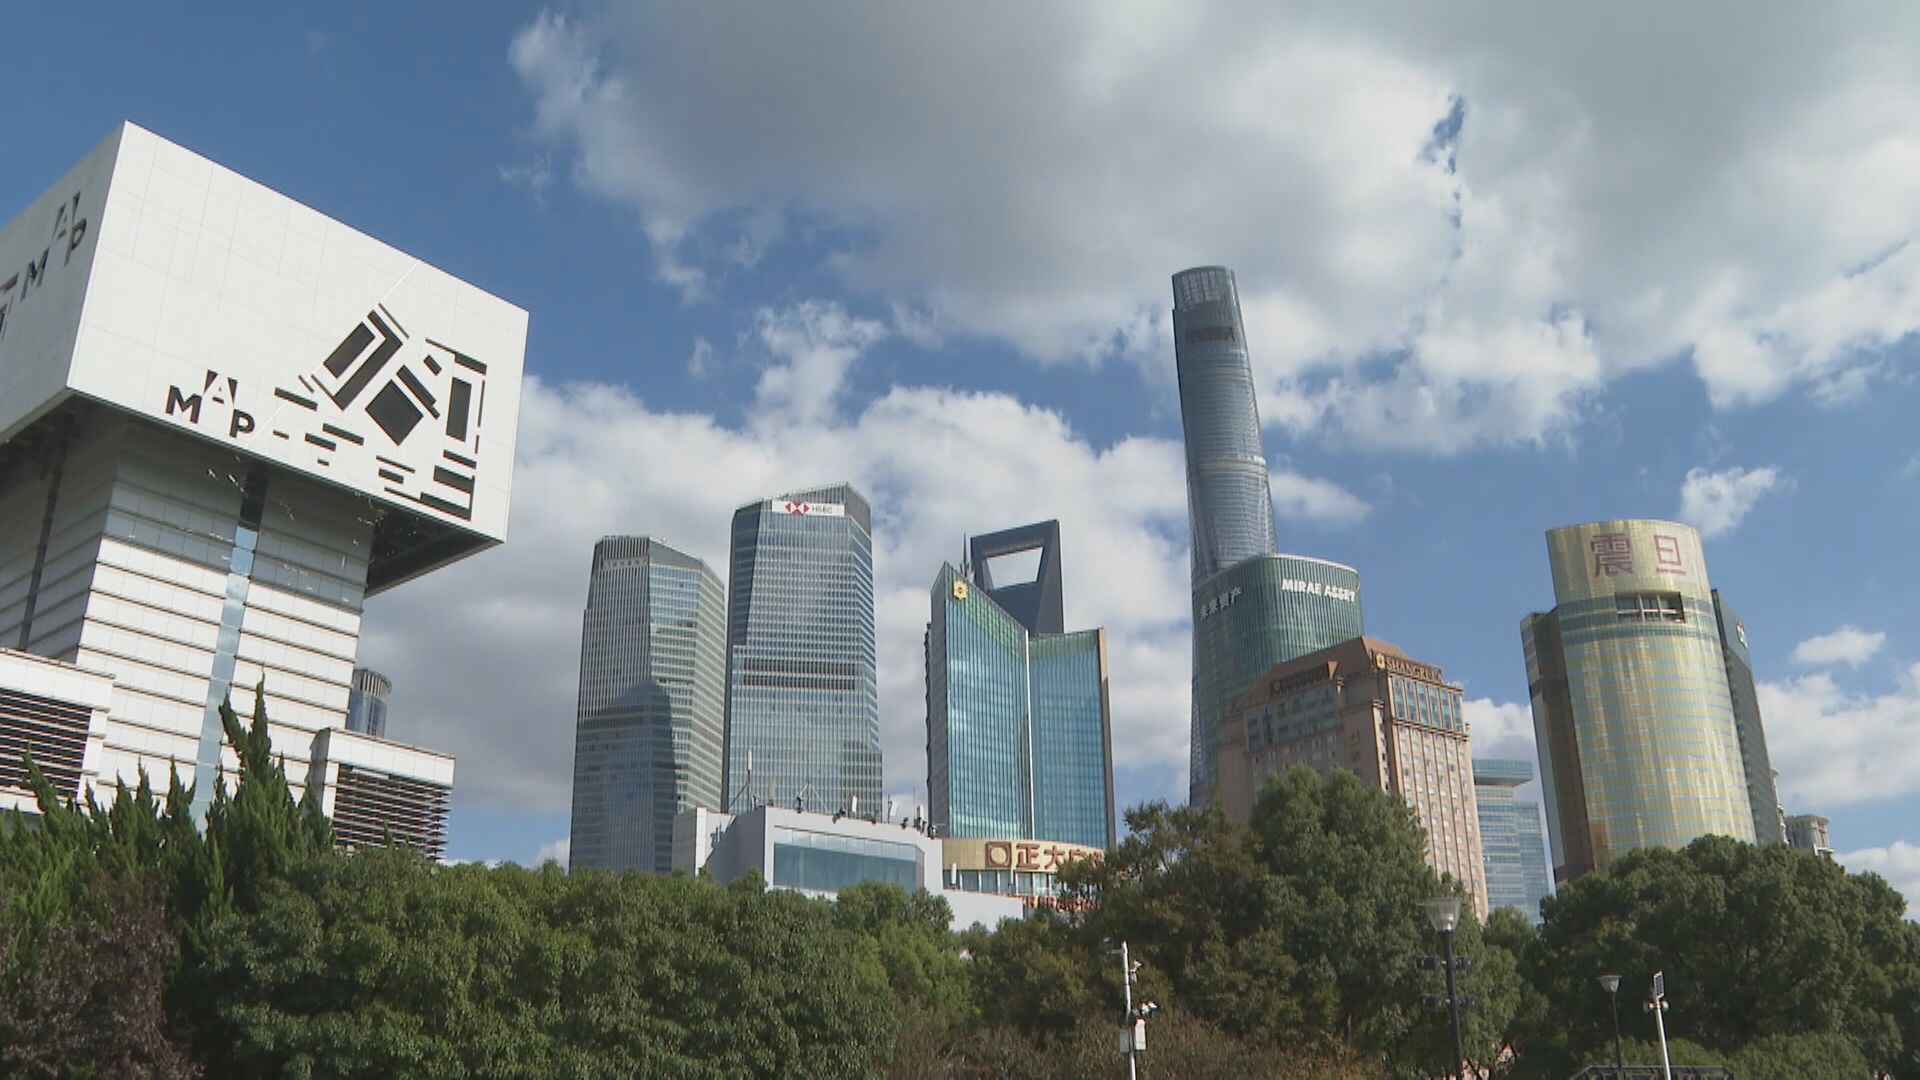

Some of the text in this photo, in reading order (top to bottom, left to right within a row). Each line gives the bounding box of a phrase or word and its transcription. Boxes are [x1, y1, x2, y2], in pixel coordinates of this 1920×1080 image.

[21, 191, 87, 301] MAP
[165, 369, 255, 438] MAP
[1591, 533, 1686, 577] 震旦
[1282, 579, 1355, 602] MIRAE ASSET
